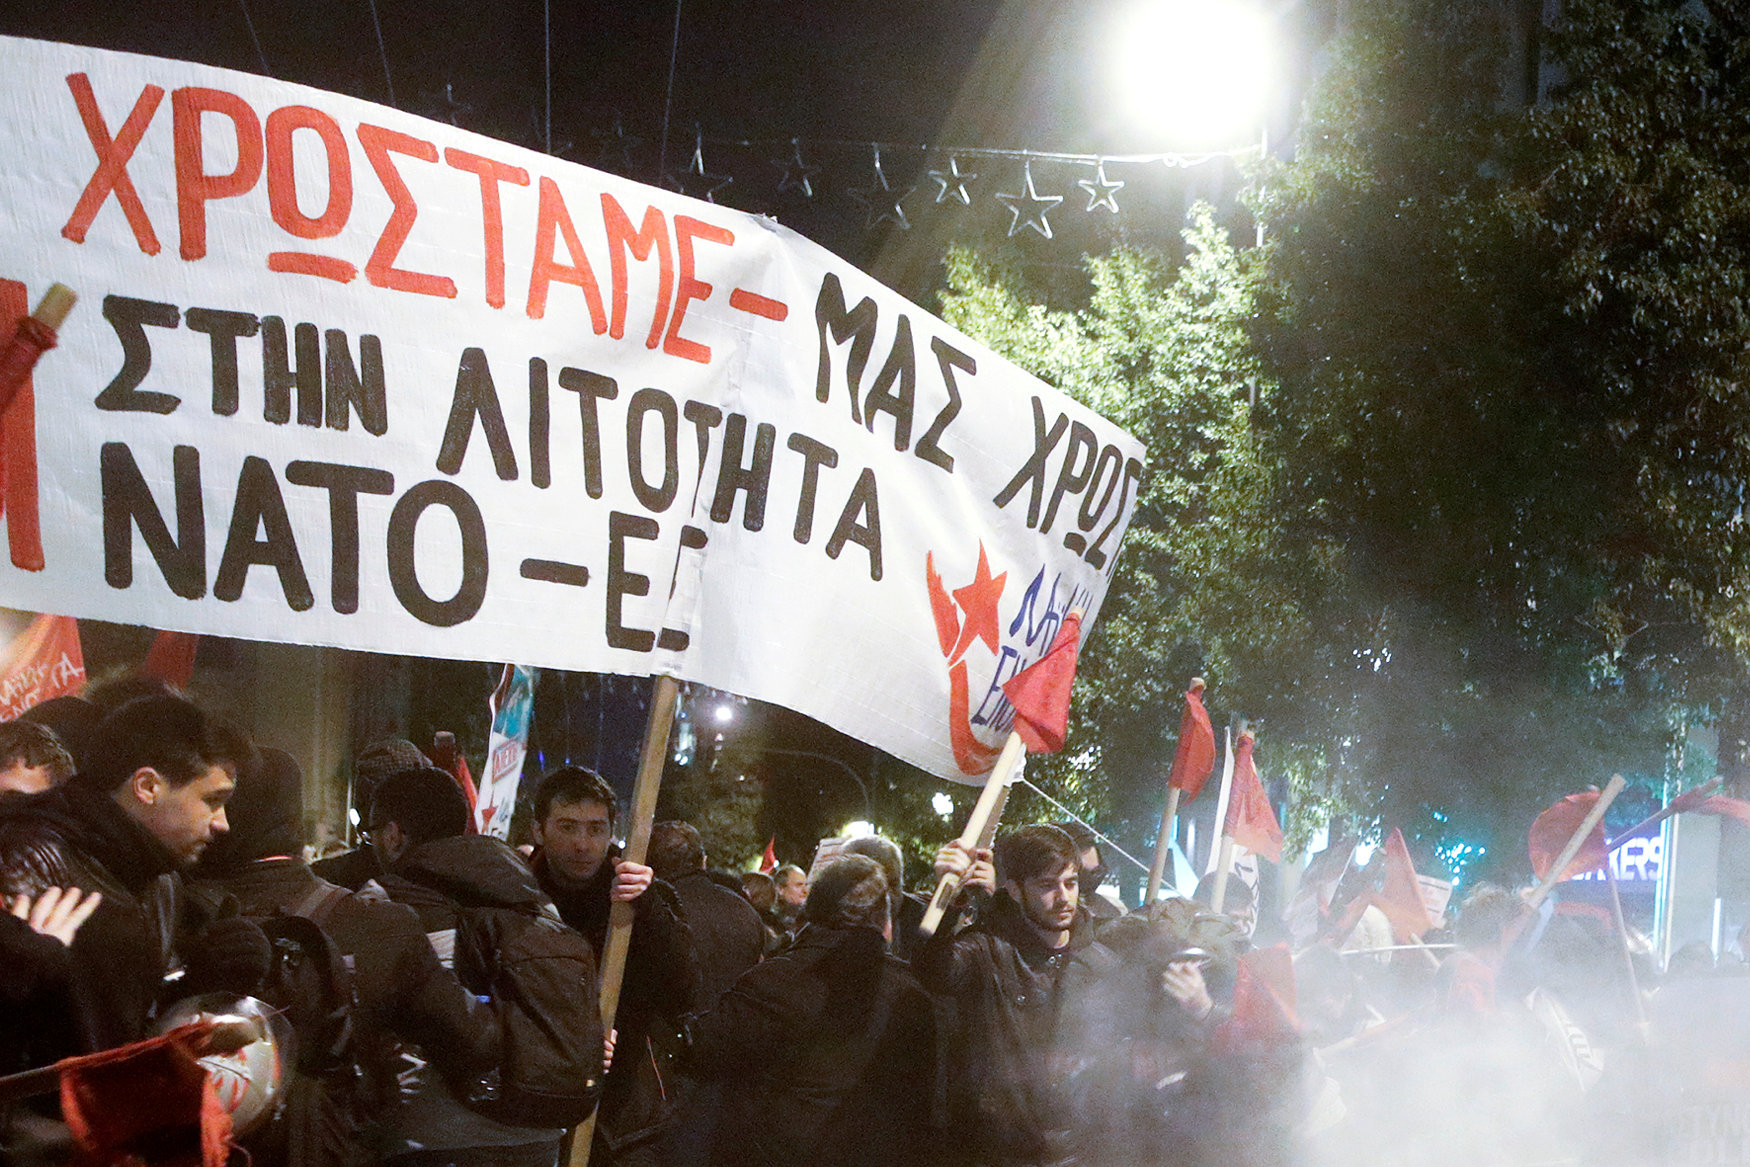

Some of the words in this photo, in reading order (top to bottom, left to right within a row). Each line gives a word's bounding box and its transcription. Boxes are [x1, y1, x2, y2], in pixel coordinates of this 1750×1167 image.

[94, 295, 388, 436] ΣΤΗΝ
[436, 347, 883, 582] ΛΙΤΟΤΗΤΑ
[815, 272, 976, 473] ΜΑΣ
[993, 396, 1146, 582] ΧΡΩΣ
